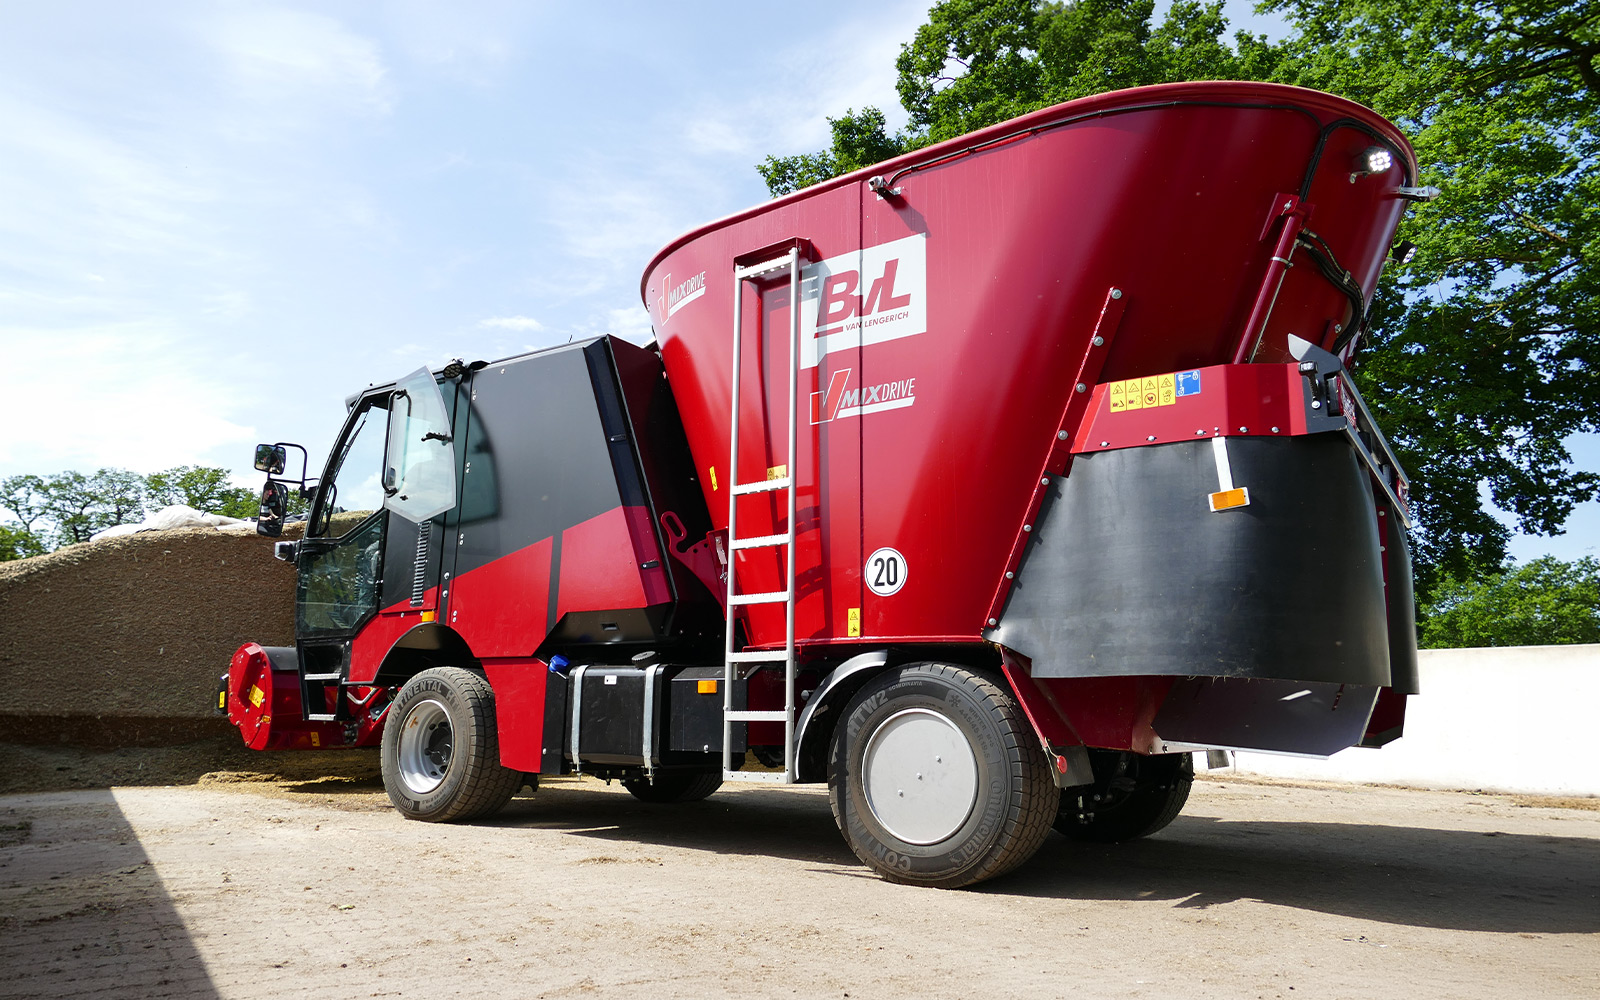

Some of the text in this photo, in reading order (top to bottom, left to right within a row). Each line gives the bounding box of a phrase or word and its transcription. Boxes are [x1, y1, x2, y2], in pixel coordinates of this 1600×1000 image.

[845, 311, 909, 332] VAN LENGERICH
[874, 556, 898, 587] 20
[847, 689, 889, 738] HTW2
[968, 706, 987, 731] WINTER
[962, 776, 1007, 862] Continental
